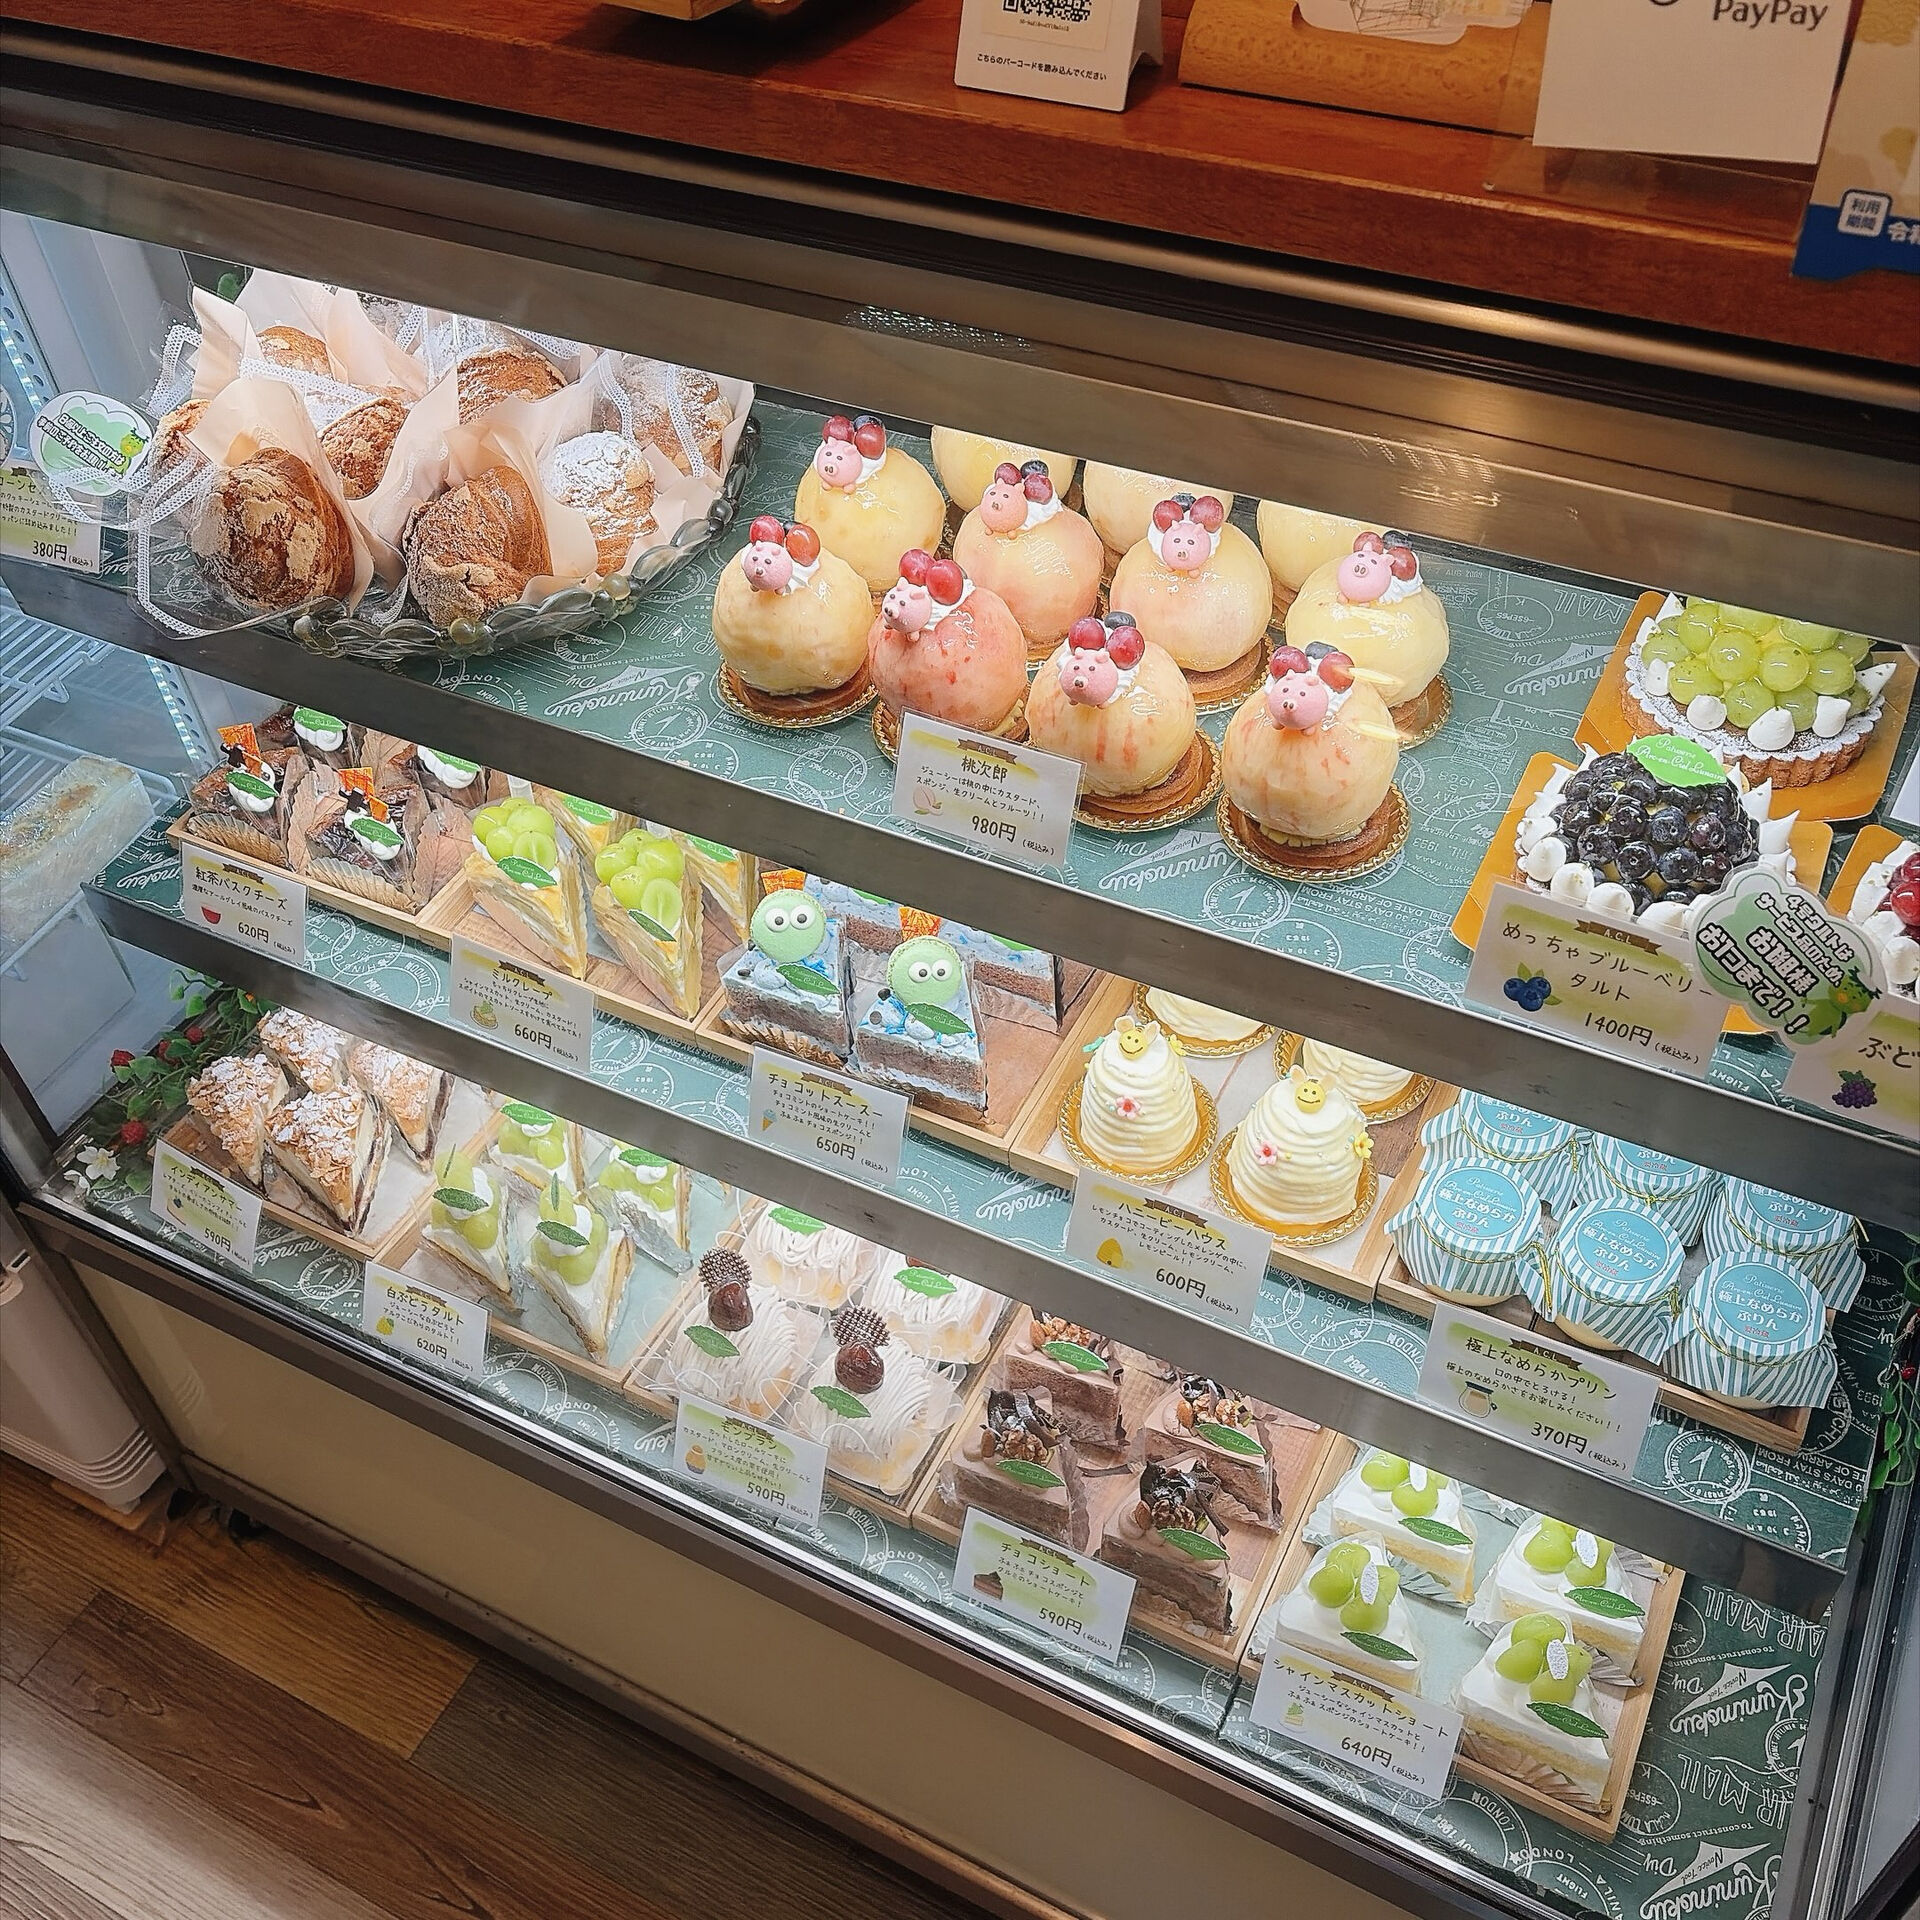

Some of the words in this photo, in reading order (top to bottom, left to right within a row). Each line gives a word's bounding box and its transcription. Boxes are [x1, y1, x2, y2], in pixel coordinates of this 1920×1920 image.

[1713, 0, 1828, 31] PayPay
[977, 53, 1107, 80] こちらのバーコードを読み込んでください
[32, 540, 68, 561] 380円
[961, 756, 1008, 783] 桃次郎
[972, 816, 1016, 843] 980円
[195, 866, 288, 910] 紅茶バスクチーズ
[238, 921, 269, 943] 620円
[1786, 894, 1854, 963] 4号タルトは
[1503, 922, 1713, 997] めっちゃブルーベリー
[491, 969, 553, 1000] ミルクレープ
[1571, 973, 1630, 1001] タルト
[514, 1024, 551, 1049] 660円
[1584, 1012, 1653, 1047] 1400円
[768, 1073, 883, 1117] チョコットスースー
[1496, 1112, 1532, 1128] ぷりん
[816, 1136, 855, 1160] 650円
[171, 1166, 243, 1211] インディアンサマー
[1118, 1202, 1228, 1251] ハニービーハウス
[1452, 1207, 1489, 1228] ぷりん
[1768, 1201, 1808, 1221] ぷりん
[204, 1228, 231, 1252] 590円
[1593, 1246, 1630, 1271] ぷりん
[1155, 1268, 1206, 1300] 600円
[387, 1286, 464, 1327] 白ぶどうタルト
[1738, 1310, 1778, 1330] ぷりん
[417, 1338, 448, 1359] 620円
[1465, 1337, 1618, 1401] 極上なめらかプリン
[1494, 1367, 1578, 1405] 口の中でとろける！
[721, 1420, 777, 1450] モンブラン
[1530, 1421, 1588, 1455] 370円
[747, 1482, 785, 1507] 590円
[1000, 1542, 1090, 1589] チョコショート
[1038, 1607, 1082, 1635] 590円
[1702, 1585, 1770, 1638] MAIL
[1273, 1659, 1449, 1738] シャインマスカットショート
[1340, 1736, 1392, 1768] 640円
[1678, 1753, 1749, 1813] MAIL
